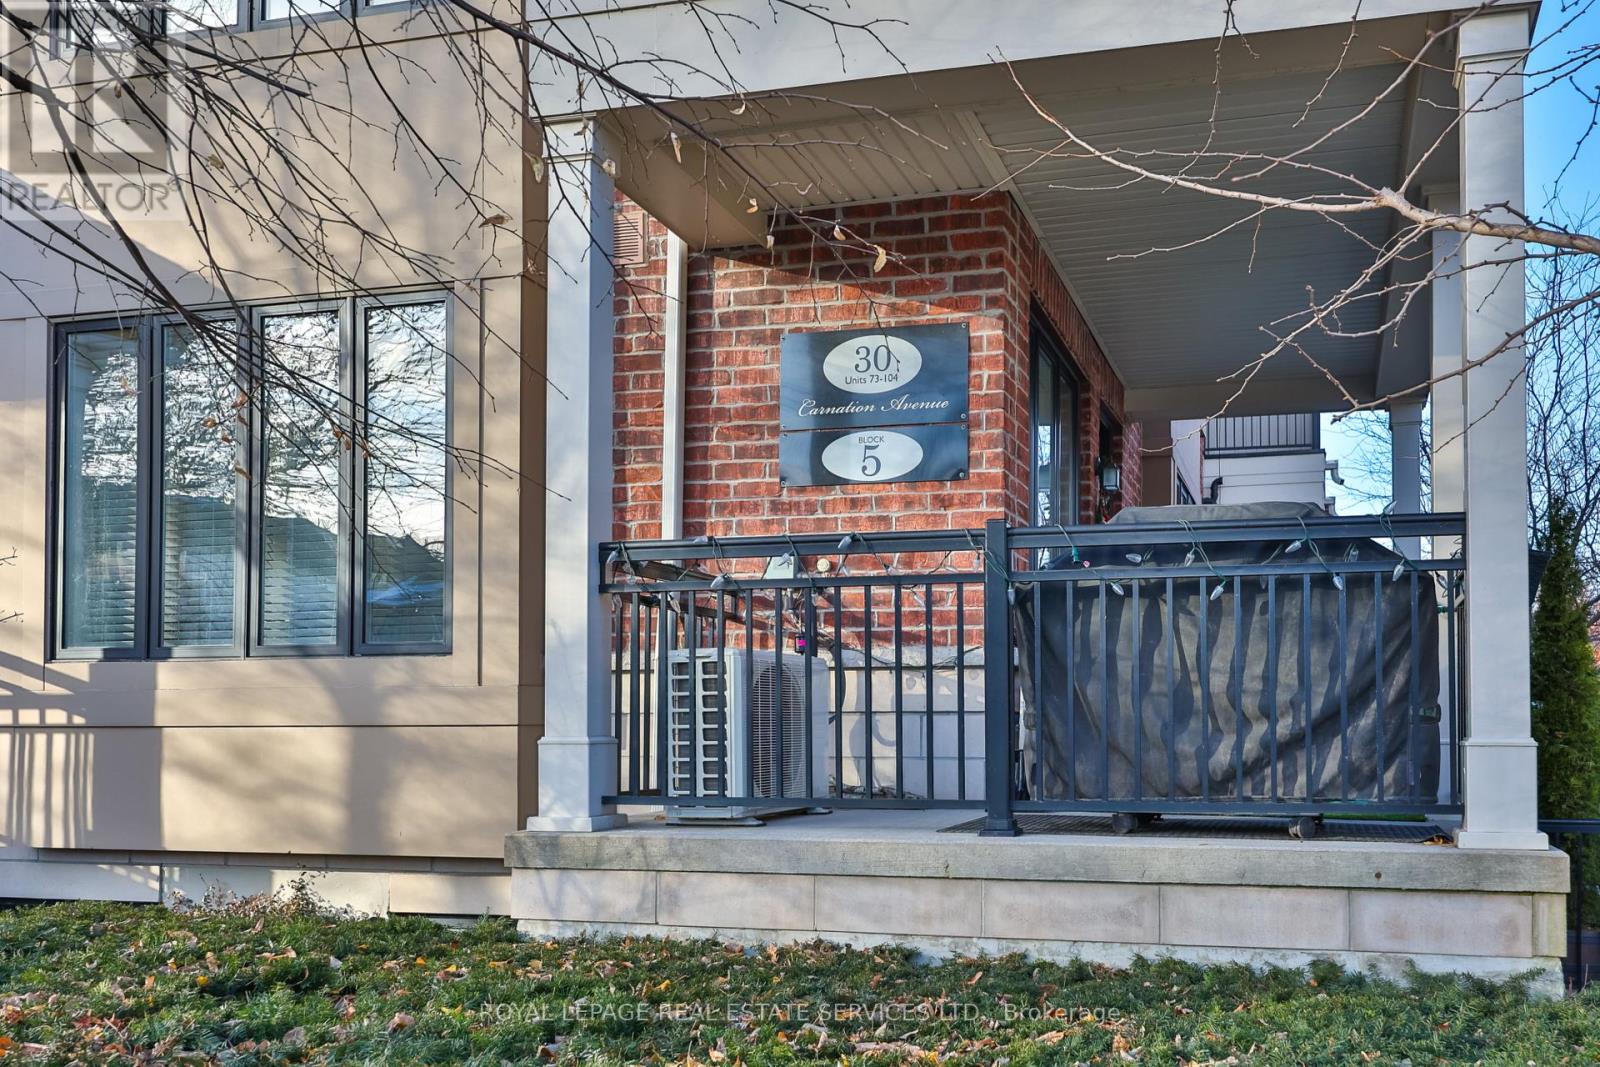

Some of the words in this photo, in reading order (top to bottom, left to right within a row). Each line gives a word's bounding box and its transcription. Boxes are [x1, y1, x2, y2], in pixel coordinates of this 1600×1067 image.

[855, 345, 891, 373] 30
[844, 376, 867, 385] Units
[869, 374, 899, 383] 73-104
[798, 399, 875, 417] Carnation
[881, 394, 950, 411] Avenue
[858, 435, 885, 444] BLOCK
[861, 444, 882, 477] 5
